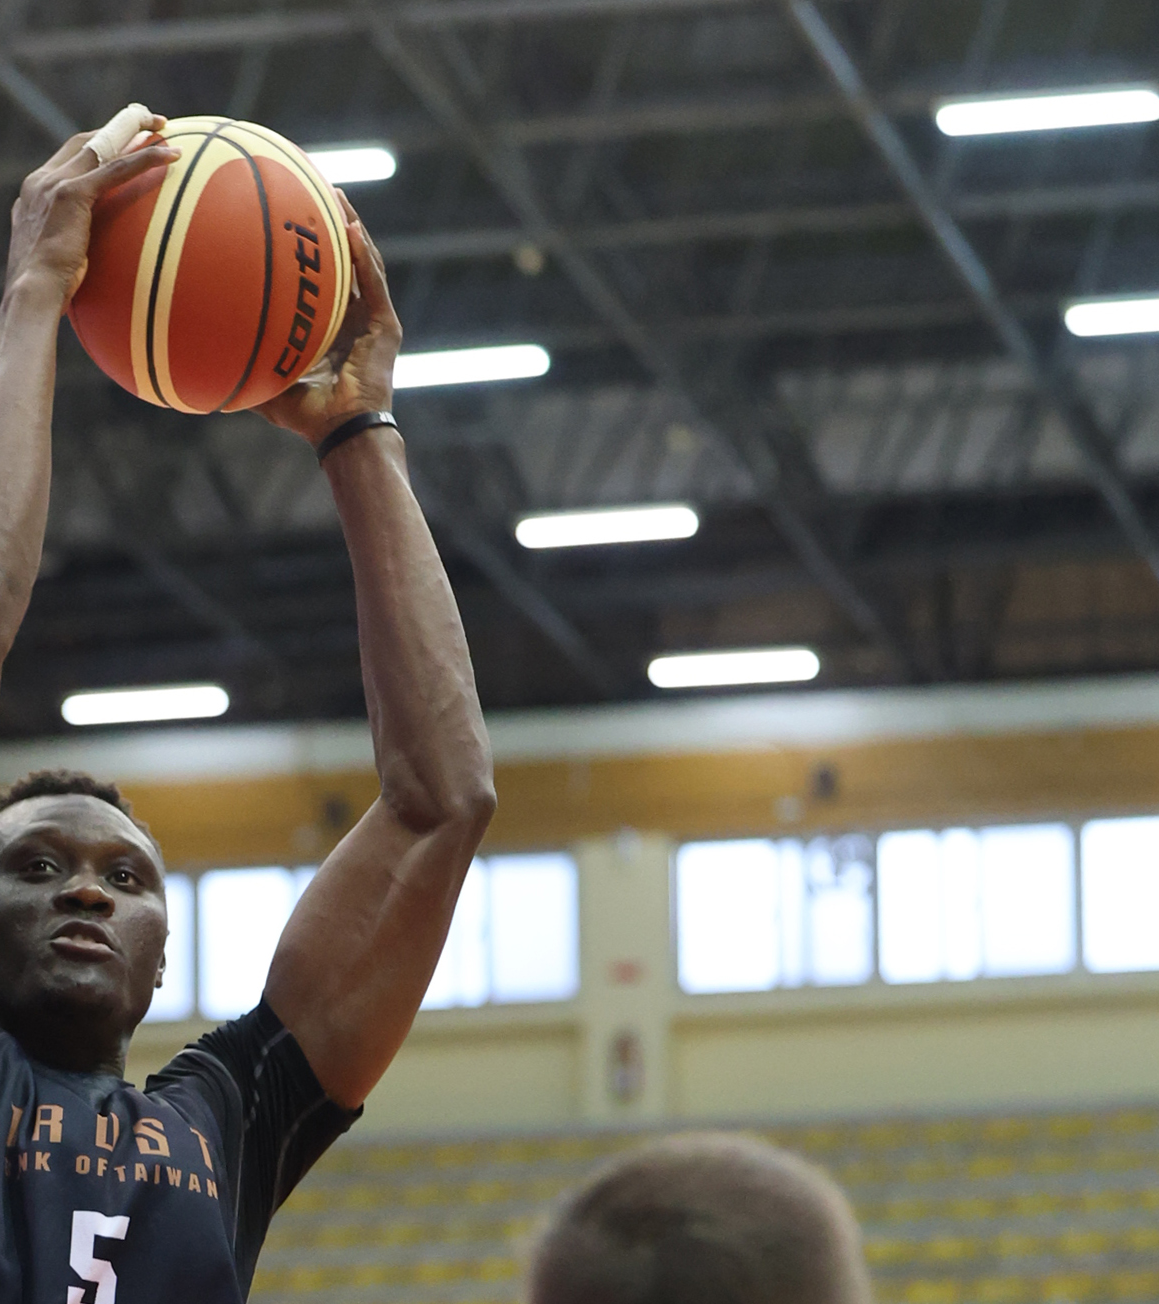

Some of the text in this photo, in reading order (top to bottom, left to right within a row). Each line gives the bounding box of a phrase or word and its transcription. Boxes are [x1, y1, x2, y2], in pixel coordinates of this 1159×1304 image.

[273, 219, 321, 379] conti
[75, 1154, 108, 1177] OF
[113, 1162, 219, 1200] TAIWAN
